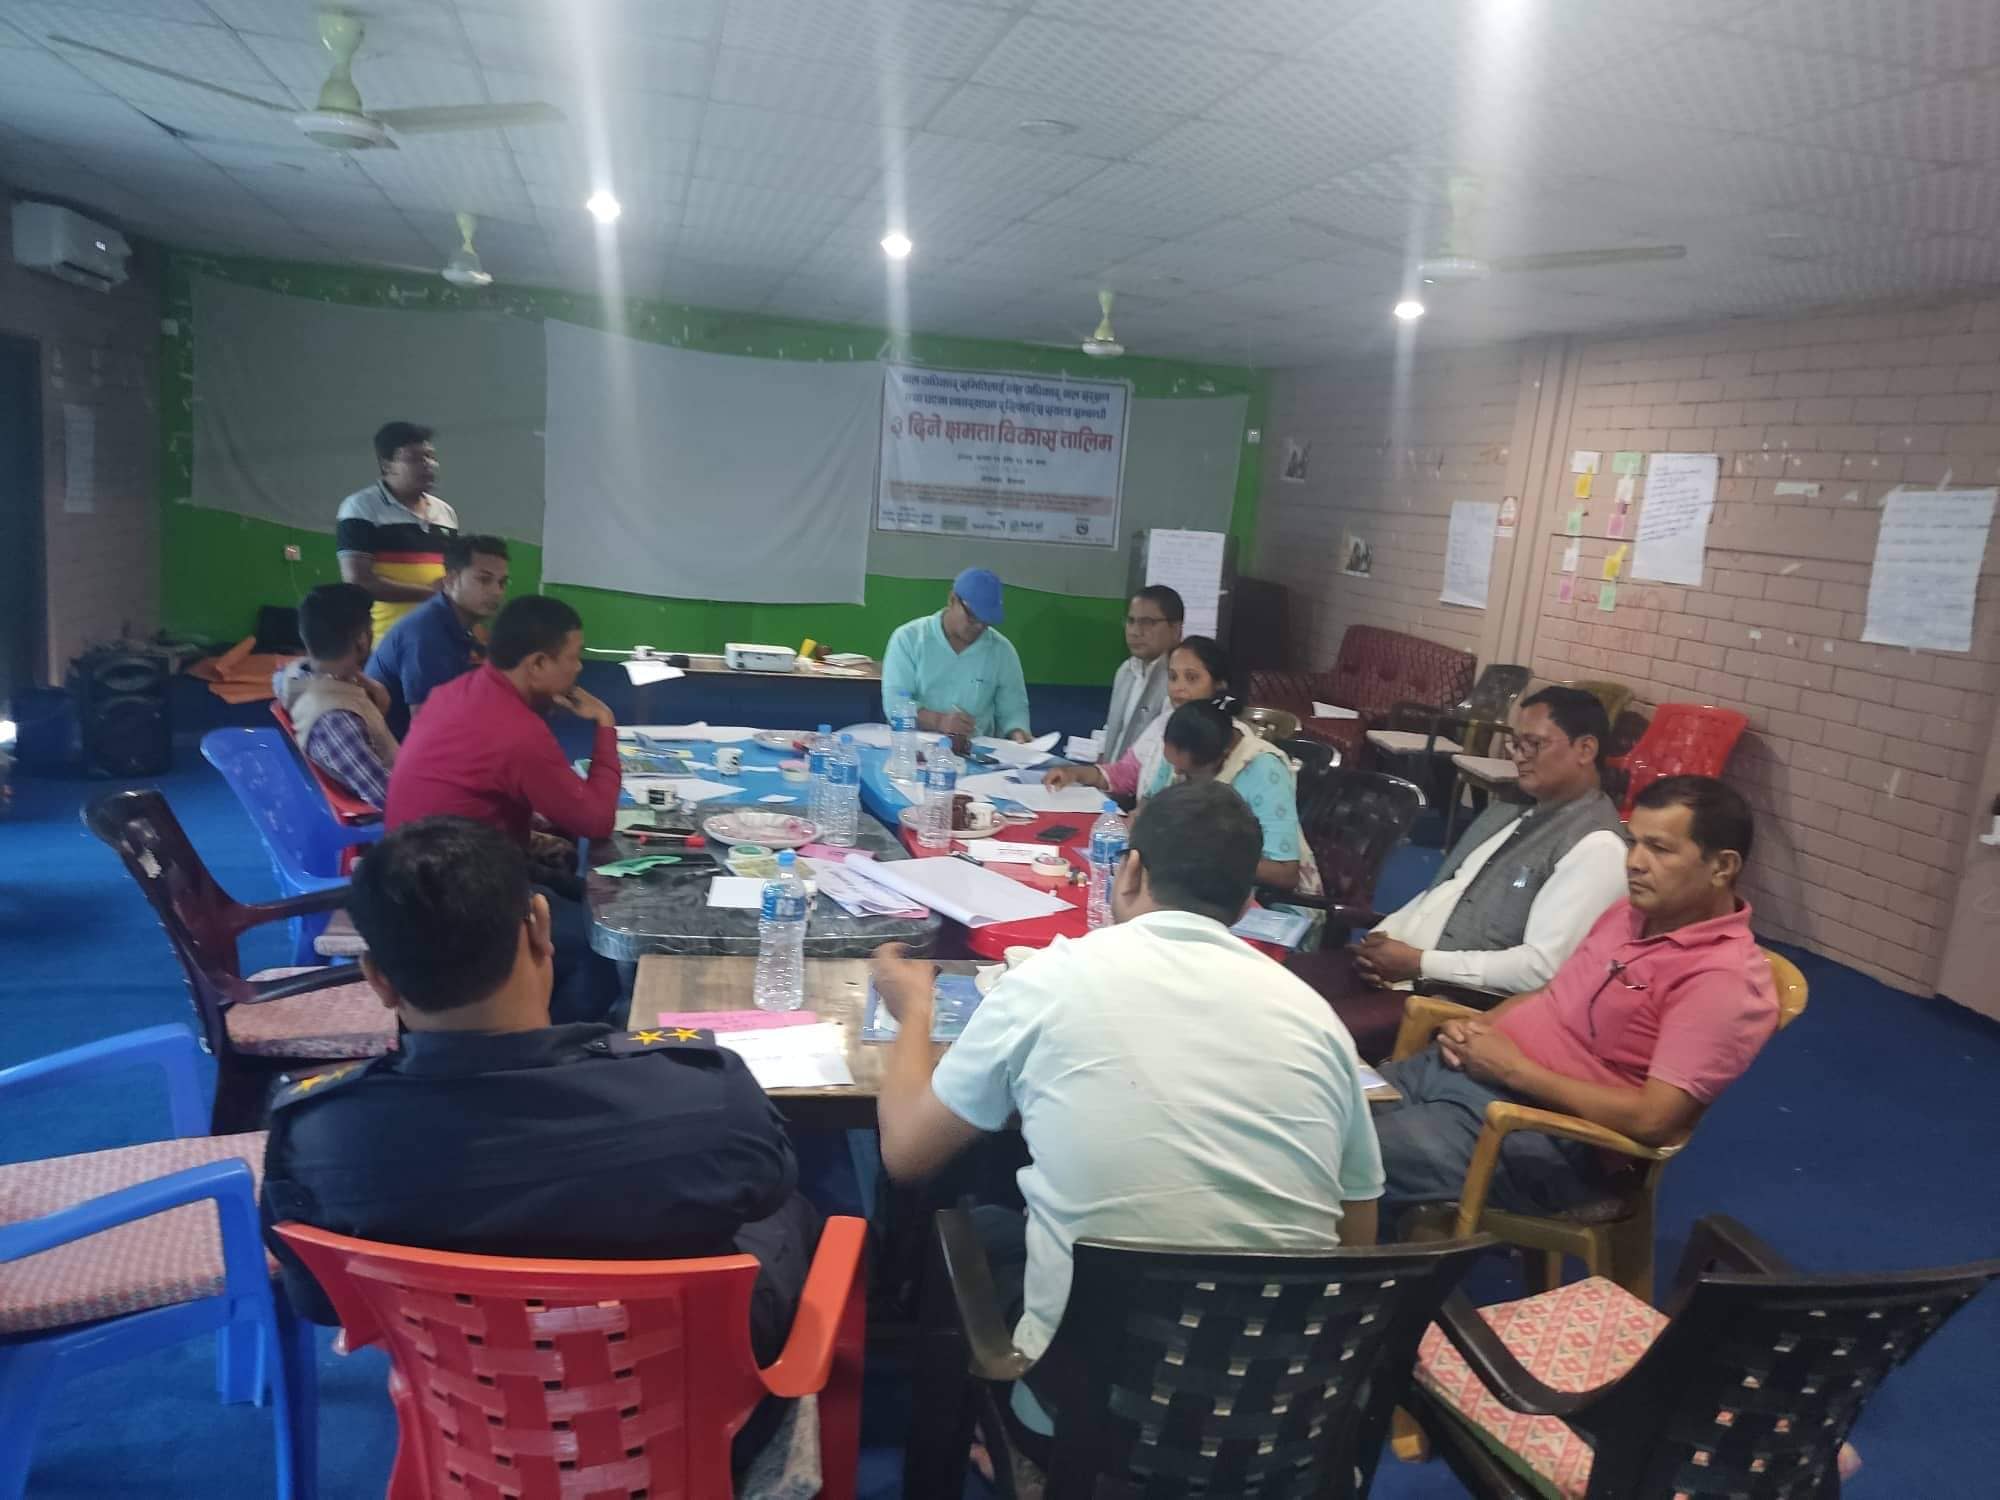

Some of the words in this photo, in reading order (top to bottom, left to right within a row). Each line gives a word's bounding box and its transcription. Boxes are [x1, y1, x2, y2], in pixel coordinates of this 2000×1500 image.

[909, 411, 942, 442] दिने
[945, 420, 995, 445] क्षमता
[999, 418, 1058, 453] विकास
[1060, 425, 1114, 453] तालिम
